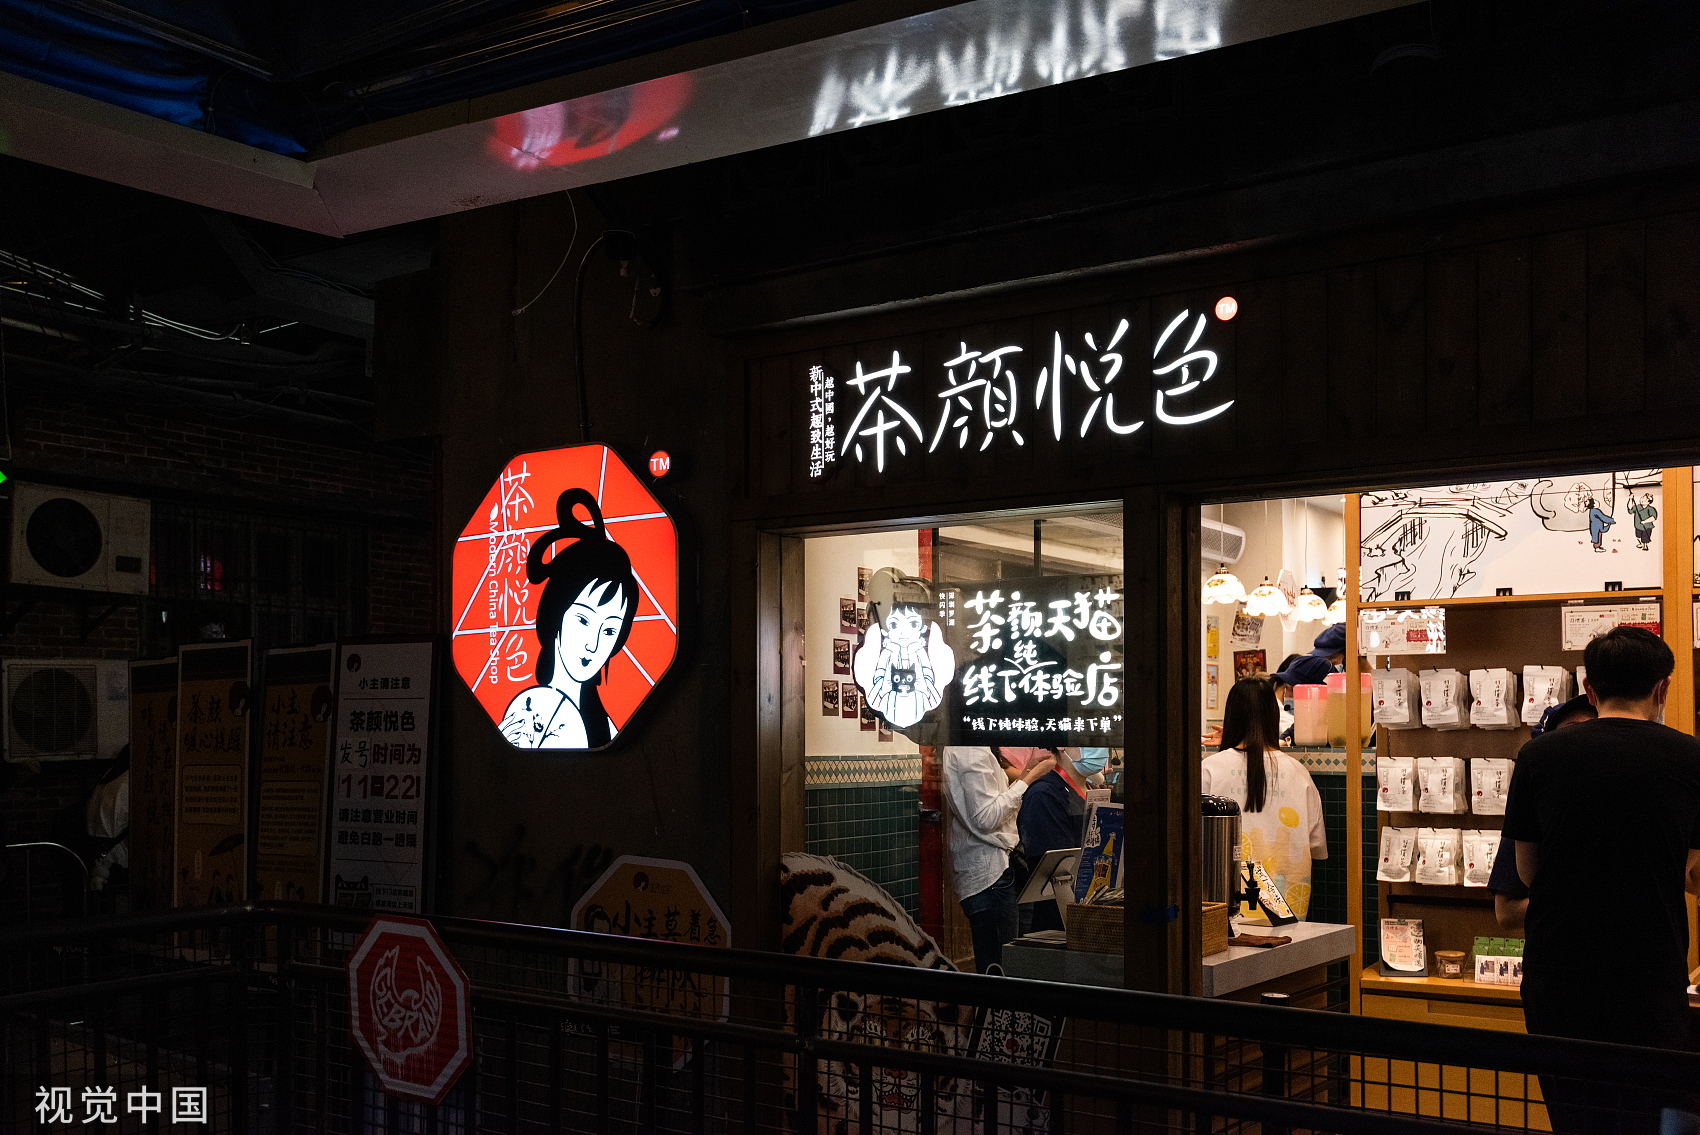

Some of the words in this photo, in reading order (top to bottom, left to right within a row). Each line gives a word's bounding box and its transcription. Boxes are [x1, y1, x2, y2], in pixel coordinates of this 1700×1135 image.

[1217, 302, 1236, 316] TM
[809, 365, 823, 478] 新中式趣致生活
[650, 457, 670, 471] TM
[489, 521, 499, 577] Modern
[489, 580, 499, 619] China
[489, 621, 499, 646] Tea
[963, 586, 1122, 654] 茶颜天猫
[489, 648, 500, 685] Shop
[359, 676, 411, 691] 小主请注意
[271, 688, 299, 715] 小主
[266, 713, 313, 751] 请注意
[349, 709, 416, 733] 茶颜悦色
[338, 808, 418, 826] 请注意营业时间
[337, 830, 417, 849] 避免白跑一趟哦
[612, 900, 722, 946] 小主莫着急
